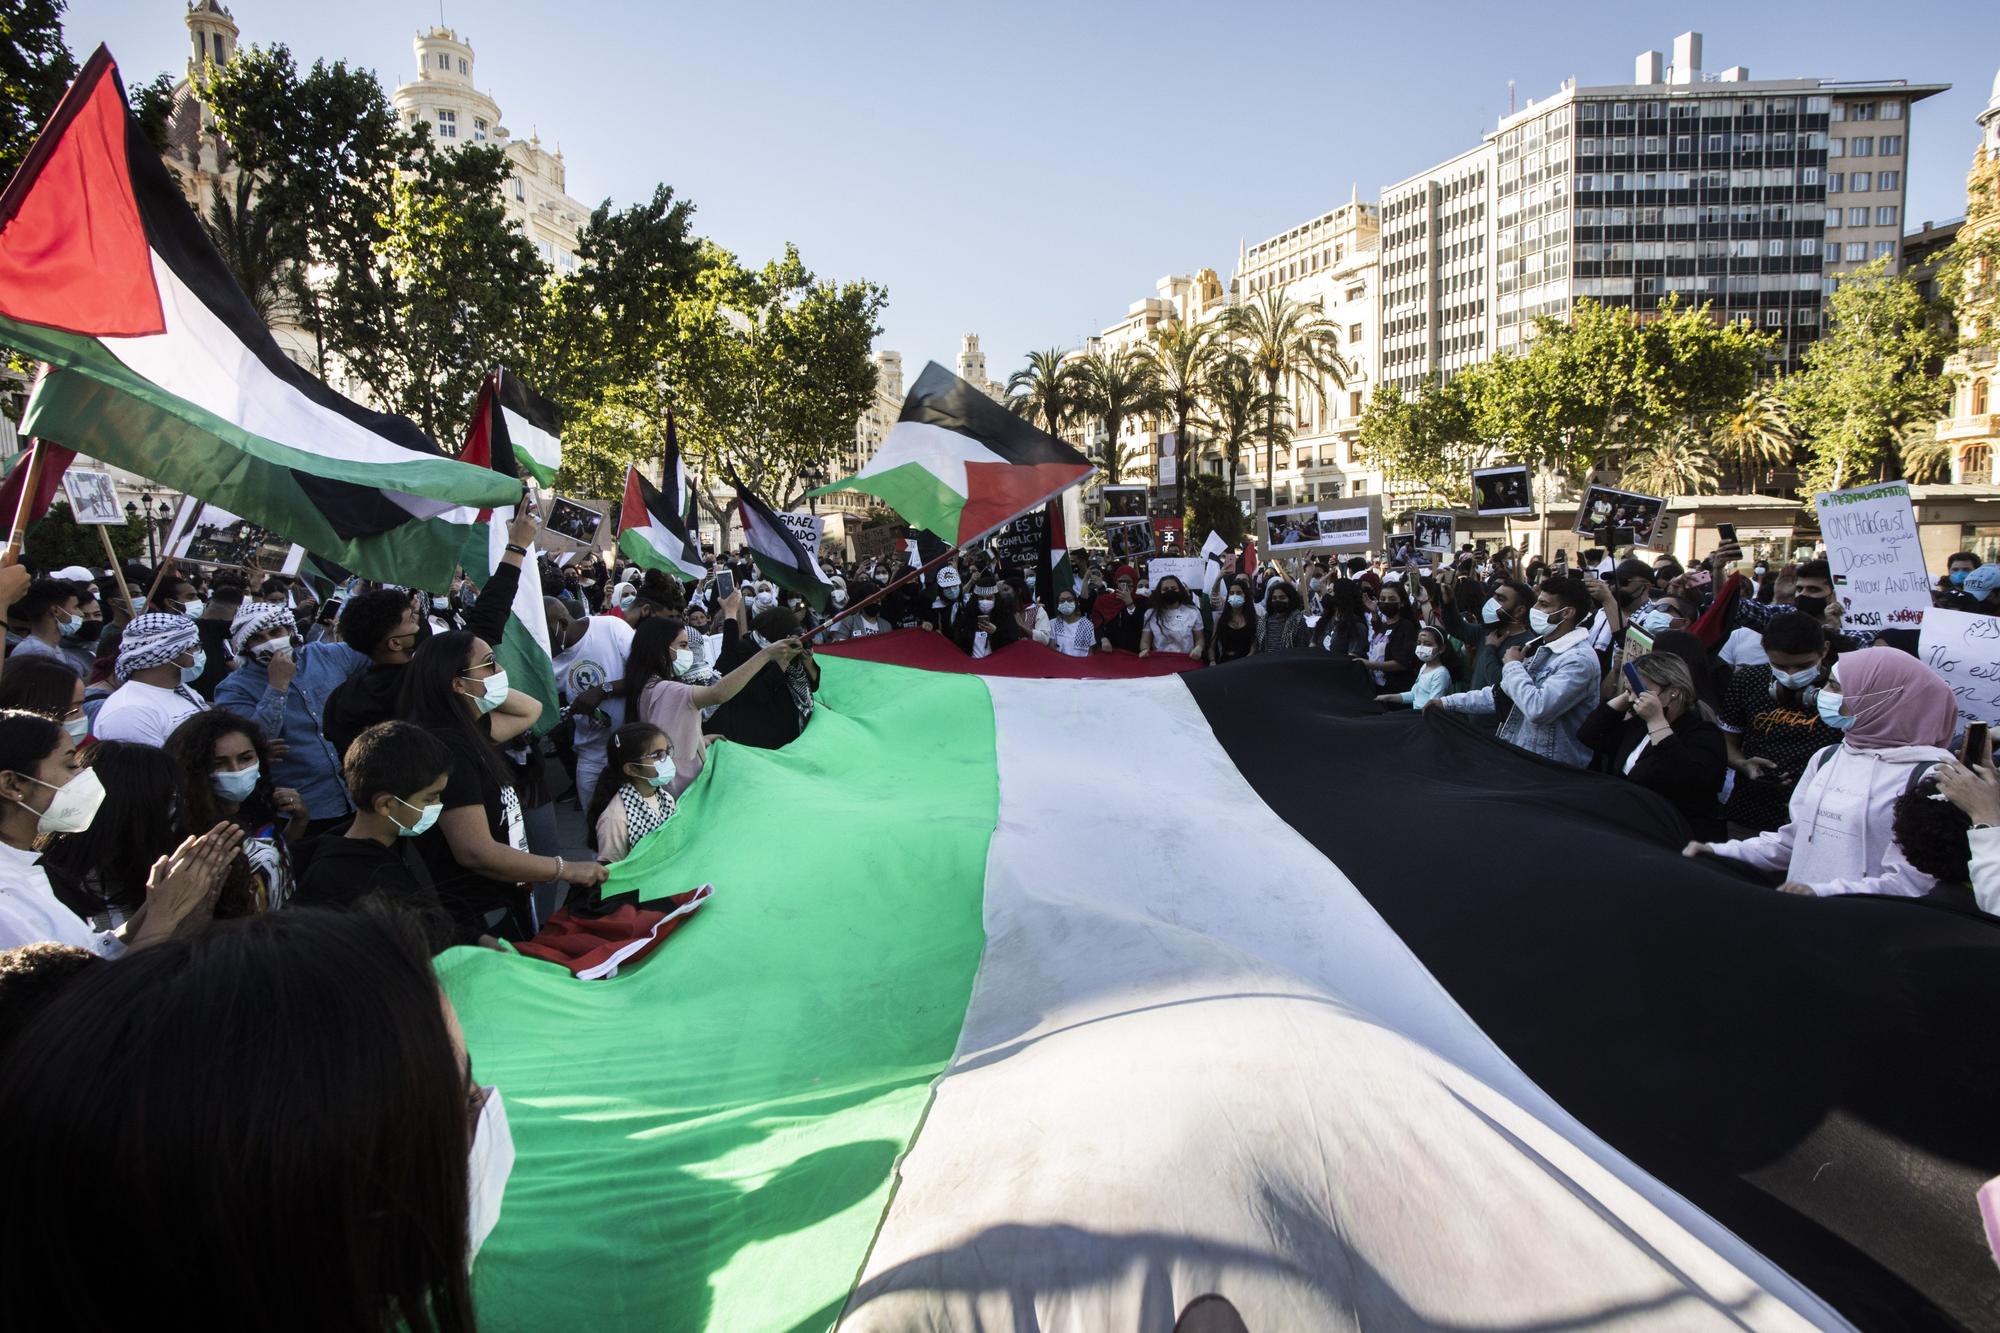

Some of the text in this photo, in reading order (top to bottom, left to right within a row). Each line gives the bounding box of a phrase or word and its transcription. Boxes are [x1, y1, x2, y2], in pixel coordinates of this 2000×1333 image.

[778, 514, 815, 529] SRAEL
[1016, 518, 1031, 532] ES
[1035, 515, 1045, 528] U
[1844, 611, 1883, 627] #AQSA
